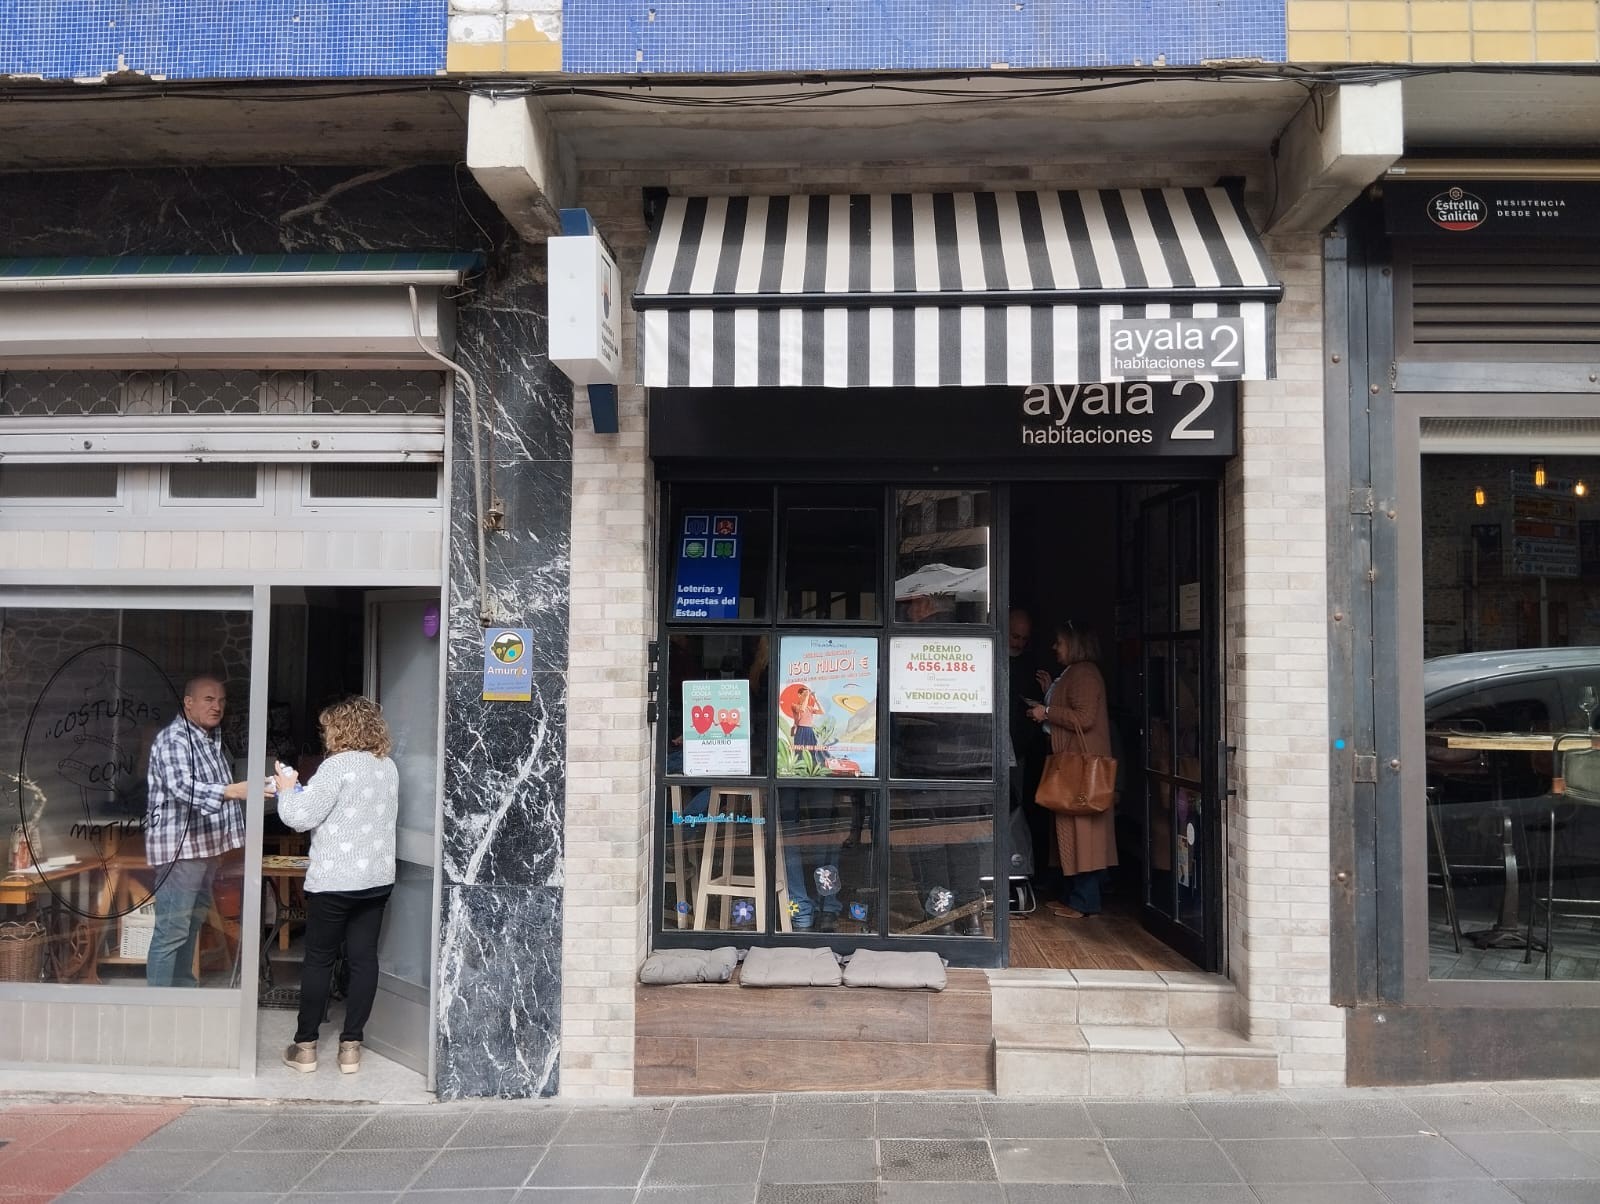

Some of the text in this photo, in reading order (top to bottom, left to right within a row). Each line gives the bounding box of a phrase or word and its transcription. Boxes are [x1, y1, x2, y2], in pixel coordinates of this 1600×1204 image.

[1436, 200, 1480, 210] Estrella
[1438, 210, 1478, 222] Galicia
[1114, 322, 1240, 367] ayala 2
[1114, 356, 1206, 369] habitaciones
[1023, 380, 1215, 440] ayala 2
[1022, 425, 1153, 445] habitaciones
[678, 584, 723, 595] Loterías y
[677, 597, 736, 606] Apuestas del
[675, 608, 708, 617] Estado
[922, 645, 961, 653] PREMIO
[859, 656, 868, 669] €
[910, 653, 973, 661] MILLONARIO
[905, 689, 978, 702] VENDIDO AQUÍ
[88, 755, 133, 783] CON
